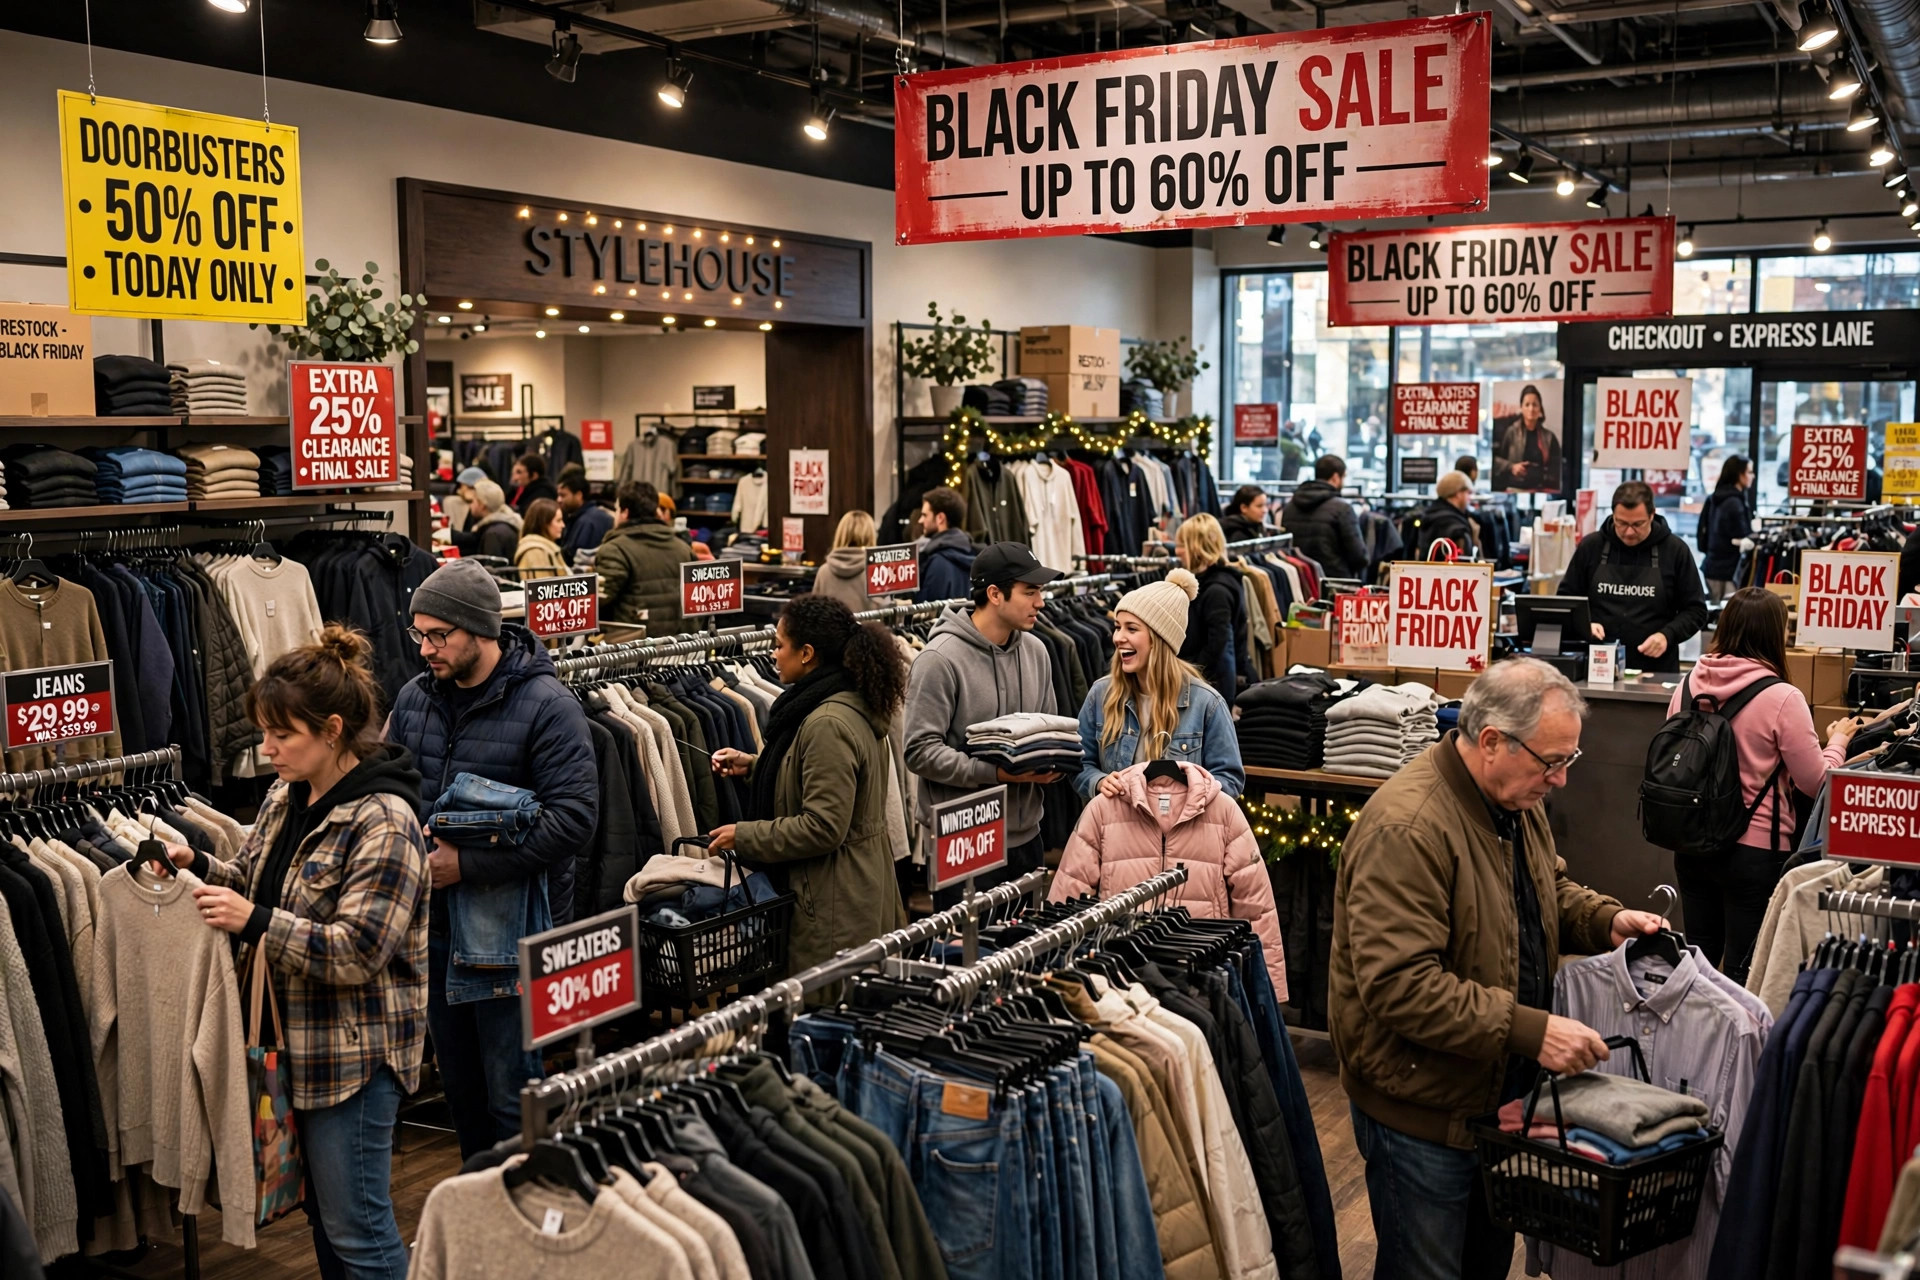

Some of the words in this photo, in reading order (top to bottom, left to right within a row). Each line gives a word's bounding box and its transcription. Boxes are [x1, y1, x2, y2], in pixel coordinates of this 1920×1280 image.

[926, 80, 1081, 162] BLACK
[1096, 60, 1279, 148] FRIDAY
[1298, 43, 1449, 132] SALE
[79, 117, 285, 186] DOORBUSTERS
[1020, 163, 1072, 220] UP
[1084, 157, 1137, 215] TO
[1149, 149, 1250, 213] 60%
[1264, 141, 1349, 205] OFF
[105, 177, 202, 247] 50%
[212, 190, 278, 252] OFF
[524, 224, 796, 297] STYLEHOUSE
[1347, 241, 1441, 283] BLACK
[1451, 235, 1558, 278] FRIDAY
[1569, 230, 1653, 275] SALE
[104, 250, 202, 300] TODAY
[210, 258, 277, 304] ONLY
[1407, 285, 1438, 316] UP
[1445, 284, 1475, 315] TO
[1483, 281, 1541, 314] 60%
[1549, 279, 1596, 312] OFF
[0, 319, 58, 337] RESTOCK
[1608, 324, 1706, 350] CHECKOUT
[1730, 322, 1817, 348] EXPRESS
[1822, 321, 1874, 347] LANE
[0, 342, 40, 359] BLACK
[43, 344, 84, 360] FRIDAY
[309, 368, 379, 394] EXTRA
[464, 386, 505, 407] SALE
[1402, 400, 1471, 415] CLEARANCE
[1606, 389, 1680, 418] BLACK
[309, 396, 382, 435] 25%
[1408, 415, 1439, 430] FINAL
[1441, 415, 1469, 430] SALE
[302, 437, 390, 459] CLEARANCE
[1603, 421, 1683, 450] FRIDAY
[1804, 428, 1854, 444] EXTRA
[794, 461, 824, 477] BLACK
[1801, 444, 1855, 469] 25%
[311, 460, 352, 481] FINAL
[355, 459, 390, 479] SALE
[1795, 469, 1860, 482] CLEARANCE
[793, 478, 824, 496] FRIDAY
[1801, 482, 1830, 495] FINAL
[1832, 483, 1858, 496] SALE
[691, 566, 730, 582] SWEATERS
[871, 564, 897, 587] 40%
[897, 563, 916, 582] OFF
[1809, 563, 1887, 597] BLACK
[537, 580, 588, 600] SWEATERS
[690, 585, 717, 603] 40%
[717, 582, 735, 600] OFF
[1398, 576, 1479, 612] BLACK
[1597, 582, 1656, 597] STYLEHOUSE
[536, 600, 566, 622] 30%
[568, 598, 591, 617] OFF
[1342, 599, 1389, 623] BLACK
[1804, 596, 1890, 631] FRIDAY
[1341, 622, 1388, 645] FRIDAY
[1395, 612, 1483, 650] FRIDAY
[32, 673, 86, 699] JEANS
[17, 698, 89, 732] $29.99
[34, 728, 58, 743] WAS
[60, 720, 97, 737] $59.99
[1844, 784, 1920, 811] CHECKOU
[940, 807, 974, 835] WINTER
[974, 799, 1000, 825] COATS
[1840, 810, 1906, 837] EXPRESS
[945, 835, 975, 867] 40%
[976, 828, 995, 857] OFF
[541, 925, 622, 974] SWEATERS
[546, 973, 591, 1015] 30%
[591, 962, 621, 998] OFF
